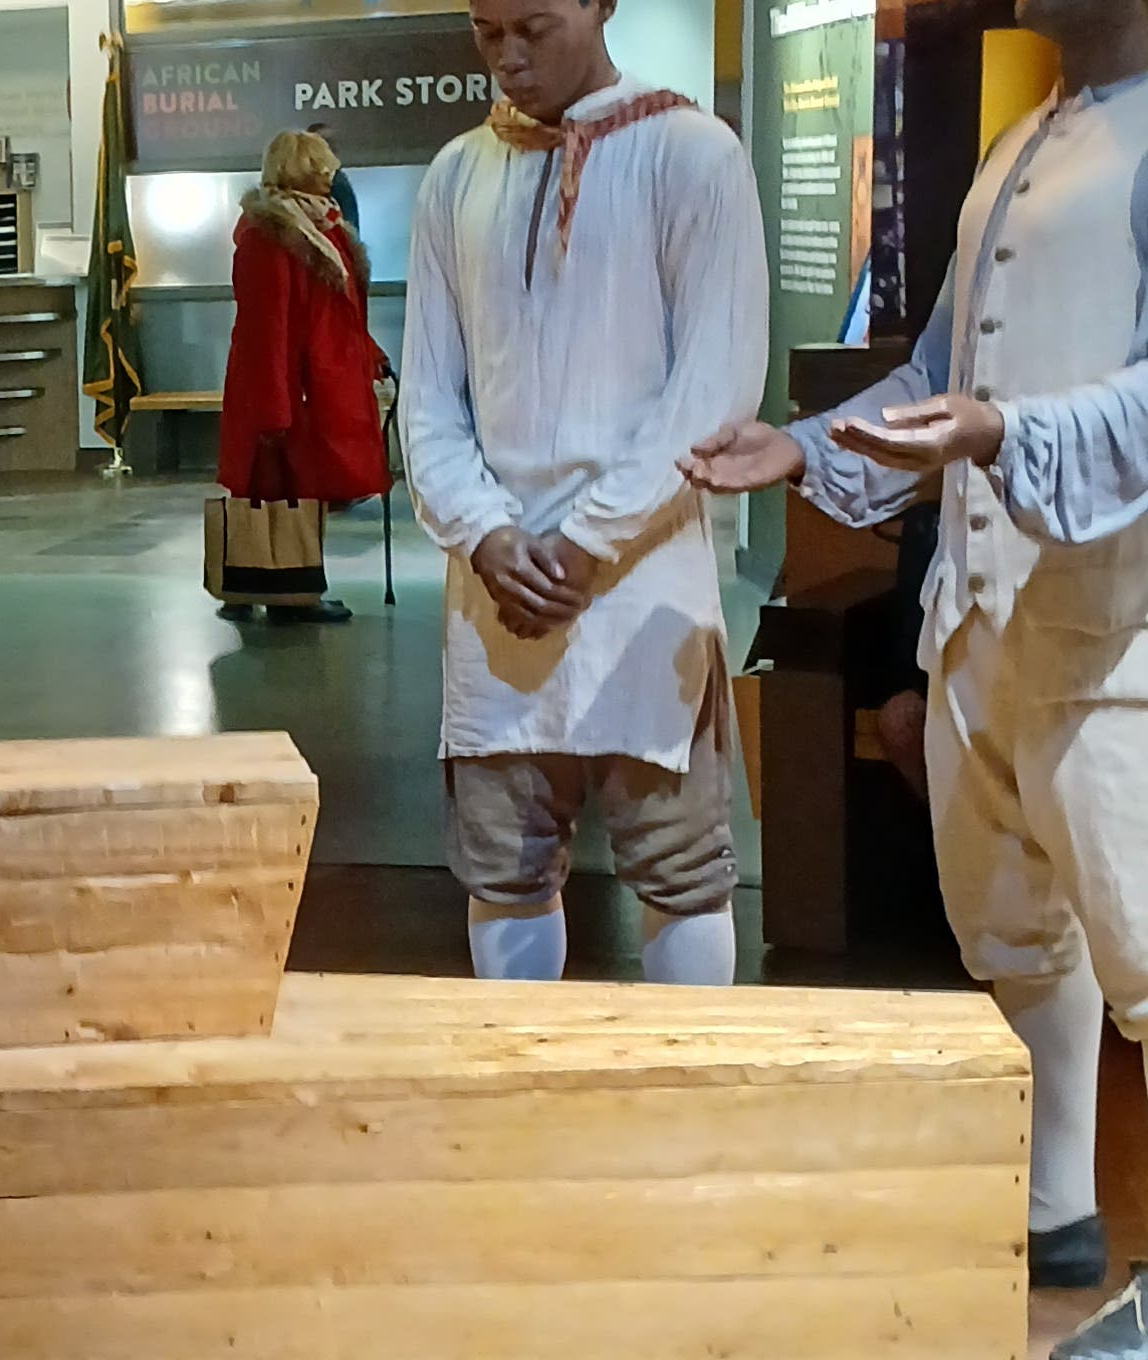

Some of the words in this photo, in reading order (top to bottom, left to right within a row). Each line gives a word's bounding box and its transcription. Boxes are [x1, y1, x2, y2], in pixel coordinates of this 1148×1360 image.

[142, 60, 261, 87] AFRICAN
[143, 90, 239, 114] BURIAL
[294, 78, 384, 110] PARK
